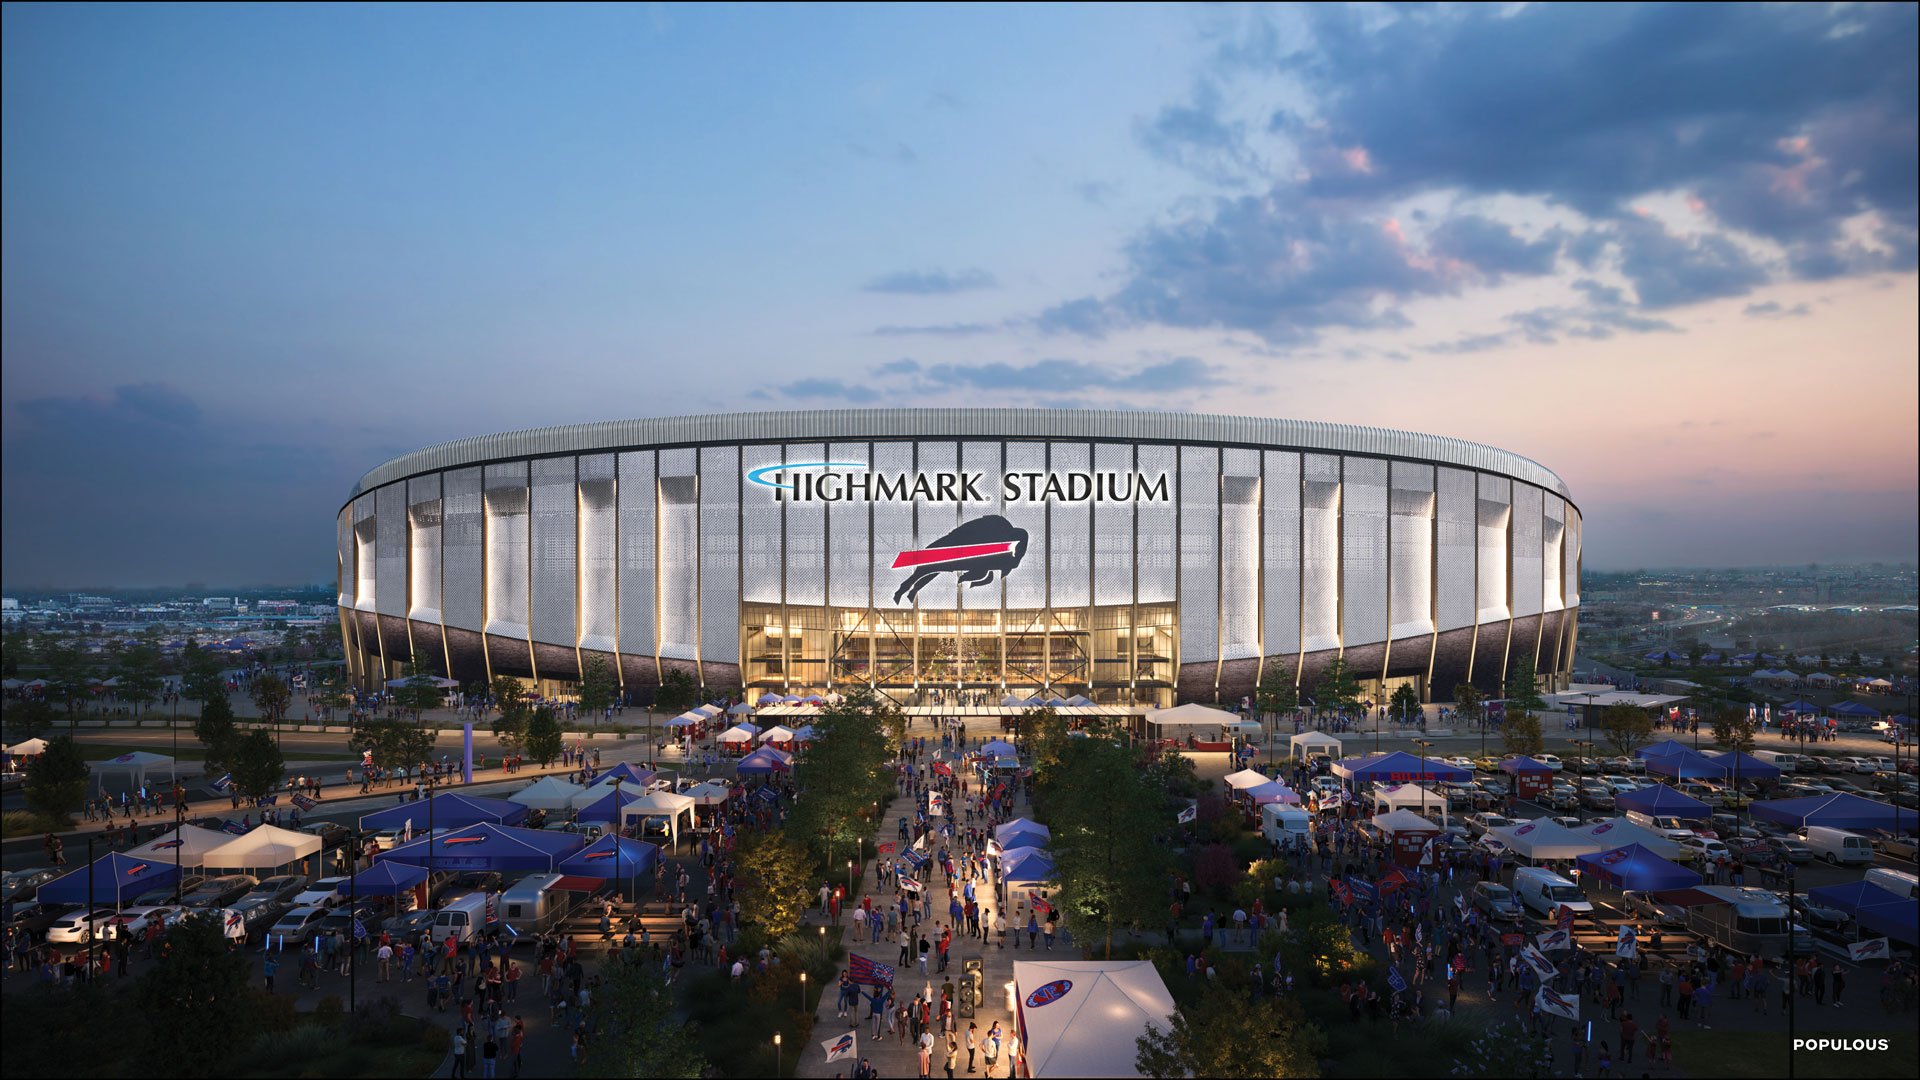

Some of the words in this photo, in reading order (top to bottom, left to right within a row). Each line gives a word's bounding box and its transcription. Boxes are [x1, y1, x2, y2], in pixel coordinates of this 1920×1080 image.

[775, 472, 984, 502] HIGHMARK
[1004, 472, 1169, 502] STADIUM
[1390, 772, 1436, 781] BILLS
